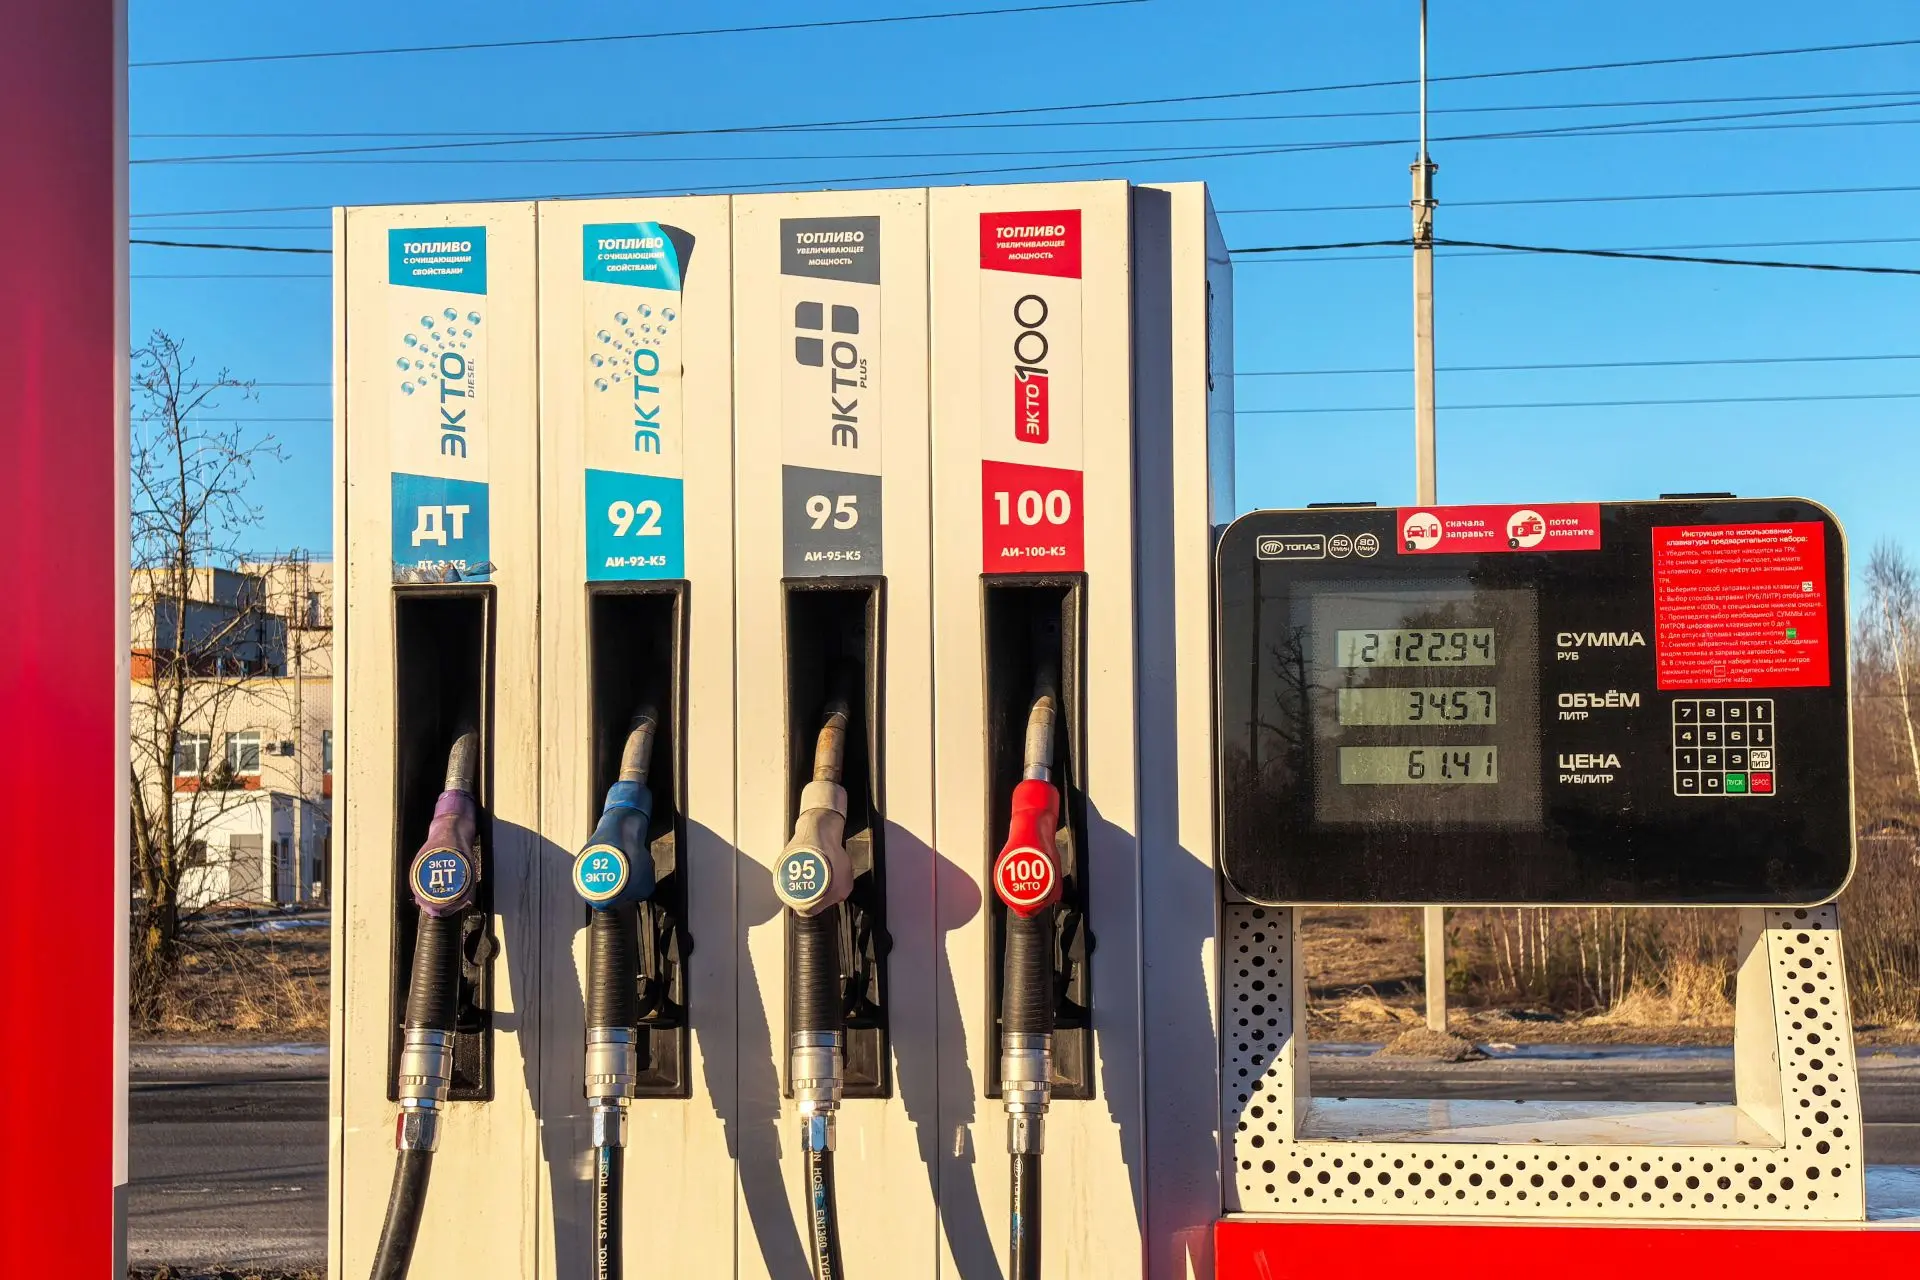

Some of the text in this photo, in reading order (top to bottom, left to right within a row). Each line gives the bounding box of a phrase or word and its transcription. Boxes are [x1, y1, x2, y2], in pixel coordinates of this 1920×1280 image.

[996, 225, 1065, 238] ТОПЛИВО
[796, 231, 864, 244] ТОПЛИВО
[404, 241, 472, 254] ТОПЛИВО
[598, 237, 664, 250] ТОПЛИВО
[996, 240, 1065, 249] УВЕЛИЧИВАЮЩЕЕ
[796, 246, 864, 254] УВЕЛИЧИВАЮЩЕЕ
[410, 256, 472, 264] ОЧИЩАЮЩИМИ
[604, 252, 664, 260] ОЧИЩАЮЩИМИ
[1008, 252, 1053, 260] МОЩНОСТЬ
[808, 258, 852, 266] МОЩНОСТЬ
[412, 267, 463, 276] СВОЙСТВАМИ
[606, 264, 657, 272] СВОЙСТВАМИ
[1014, 294, 1048, 380] 100
[831, 341, 858, 449] ЭКТО
[440, 352, 466, 458] ЭКТО
[634, 349, 660, 454] ЭКТО
[1026, 384, 1040, 435] ЭКТО
[806, 494, 858, 530] 95
[994, 489, 1071, 526] 100
[608, 500, 662, 536] 92
[411, 505, 470, 546] ДТ
[1446, 530, 1494, 539] заправьте
[1711, 537, 1778, 546] предварительного
[1780, 535, 1808, 544] набора:
[804, 551, 861, 562] АИ-95-К5
[1001, 546, 1066, 557] АИ-100-К5
[605, 555, 666, 567] АИ-92-К5
[1556, 632, 1646, 647] СУММА
[1361, 632, 1490, 663] 2122.94
[1557, 651, 1580, 661] РУБ
[1557, 689, 1641, 708] ОБЪЁМ
[1408, 690, 1491, 720] 34.57
[1558, 711, 1589, 721] ЛИТР
[1681, 708, 1691, 717] 7
[1706, 708, 1716, 717] 8
[1730, 708, 1740, 717] 9
[1682, 731, 1692, 740] 4
[1706, 732, 1717, 740] 5
[1731, 731, 1741, 740] 6
[1407, 750, 1493, 779] 61.41
[1558, 753, 1622, 771] ЦЕНА
[1684, 755, 1691, 764] 1
[1706, 755, 1717, 764] 2
[1732, 755, 1742, 764] 3
[1559, 774, 1614, 784] РУБ/ЛИТР
[1708, 779, 1718, 787] 0
[429, 860, 456, 869] ЭКТО
[593, 858, 609, 870] 92
[788, 860, 816, 880] 95
[1006, 860, 1045, 881] 100
[429, 868, 456, 888] ДТ
[585, 872, 616, 883] ЭКТО
[789, 881, 816, 891] ЭКТО
[1013, 882, 1040, 892] ЭКТО
[600, 1157, 609, 1186] HOSE
[814, 1167, 823, 1198] HOSE
[599, 1192, 608, 1239] STATION
[817, 1210, 827, 1248] EN1360
[821, 1253, 832, 1280] TYPE
